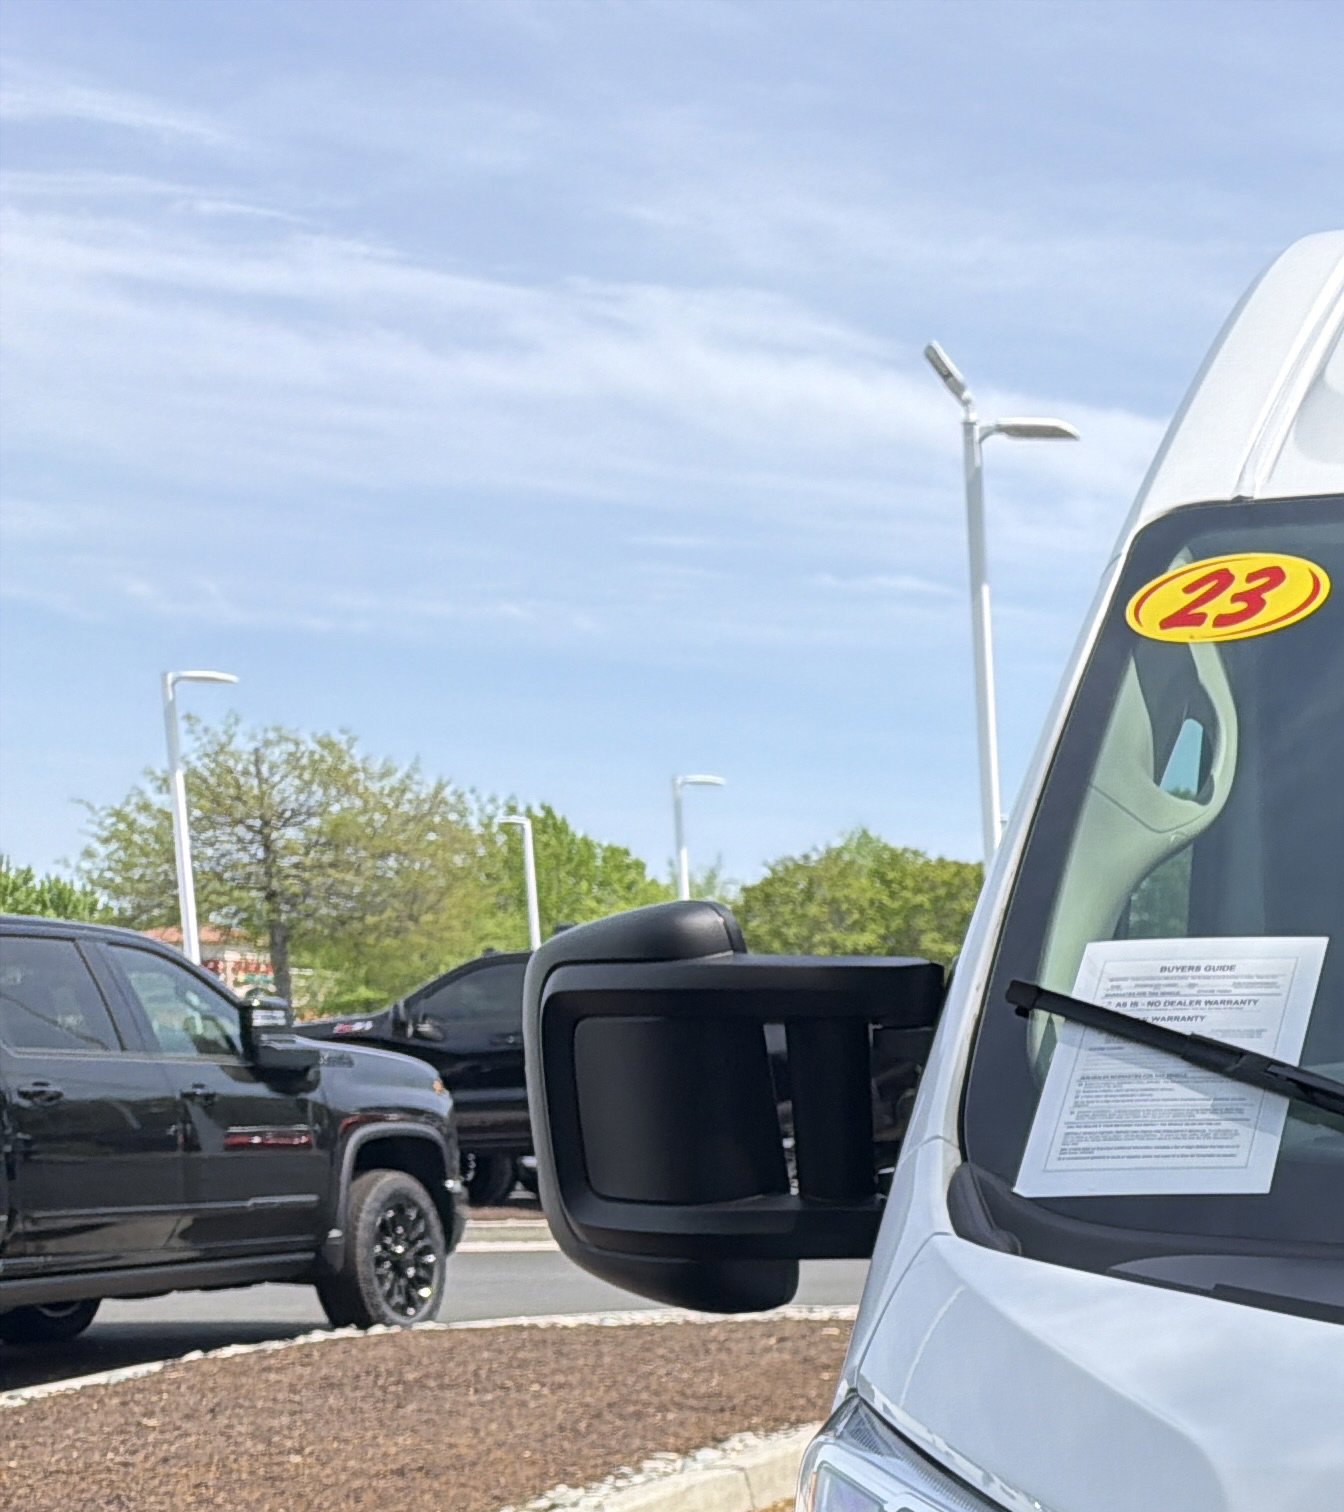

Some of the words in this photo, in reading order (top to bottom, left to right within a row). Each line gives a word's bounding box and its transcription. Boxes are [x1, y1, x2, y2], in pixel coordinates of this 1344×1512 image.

[1159, 565, 1286, 630] 23
[1159, 964, 1201, 973] BUYERS
[1203, 964, 1236, 973] GUIDE
[1147, 1000, 1161, 1008] NO
[1163, 1000, 1201, 1008] DEALER
[1203, 999, 1259, 1007] WARRANTY
[1151, 1015, 1206, 1023] WARRANTY
